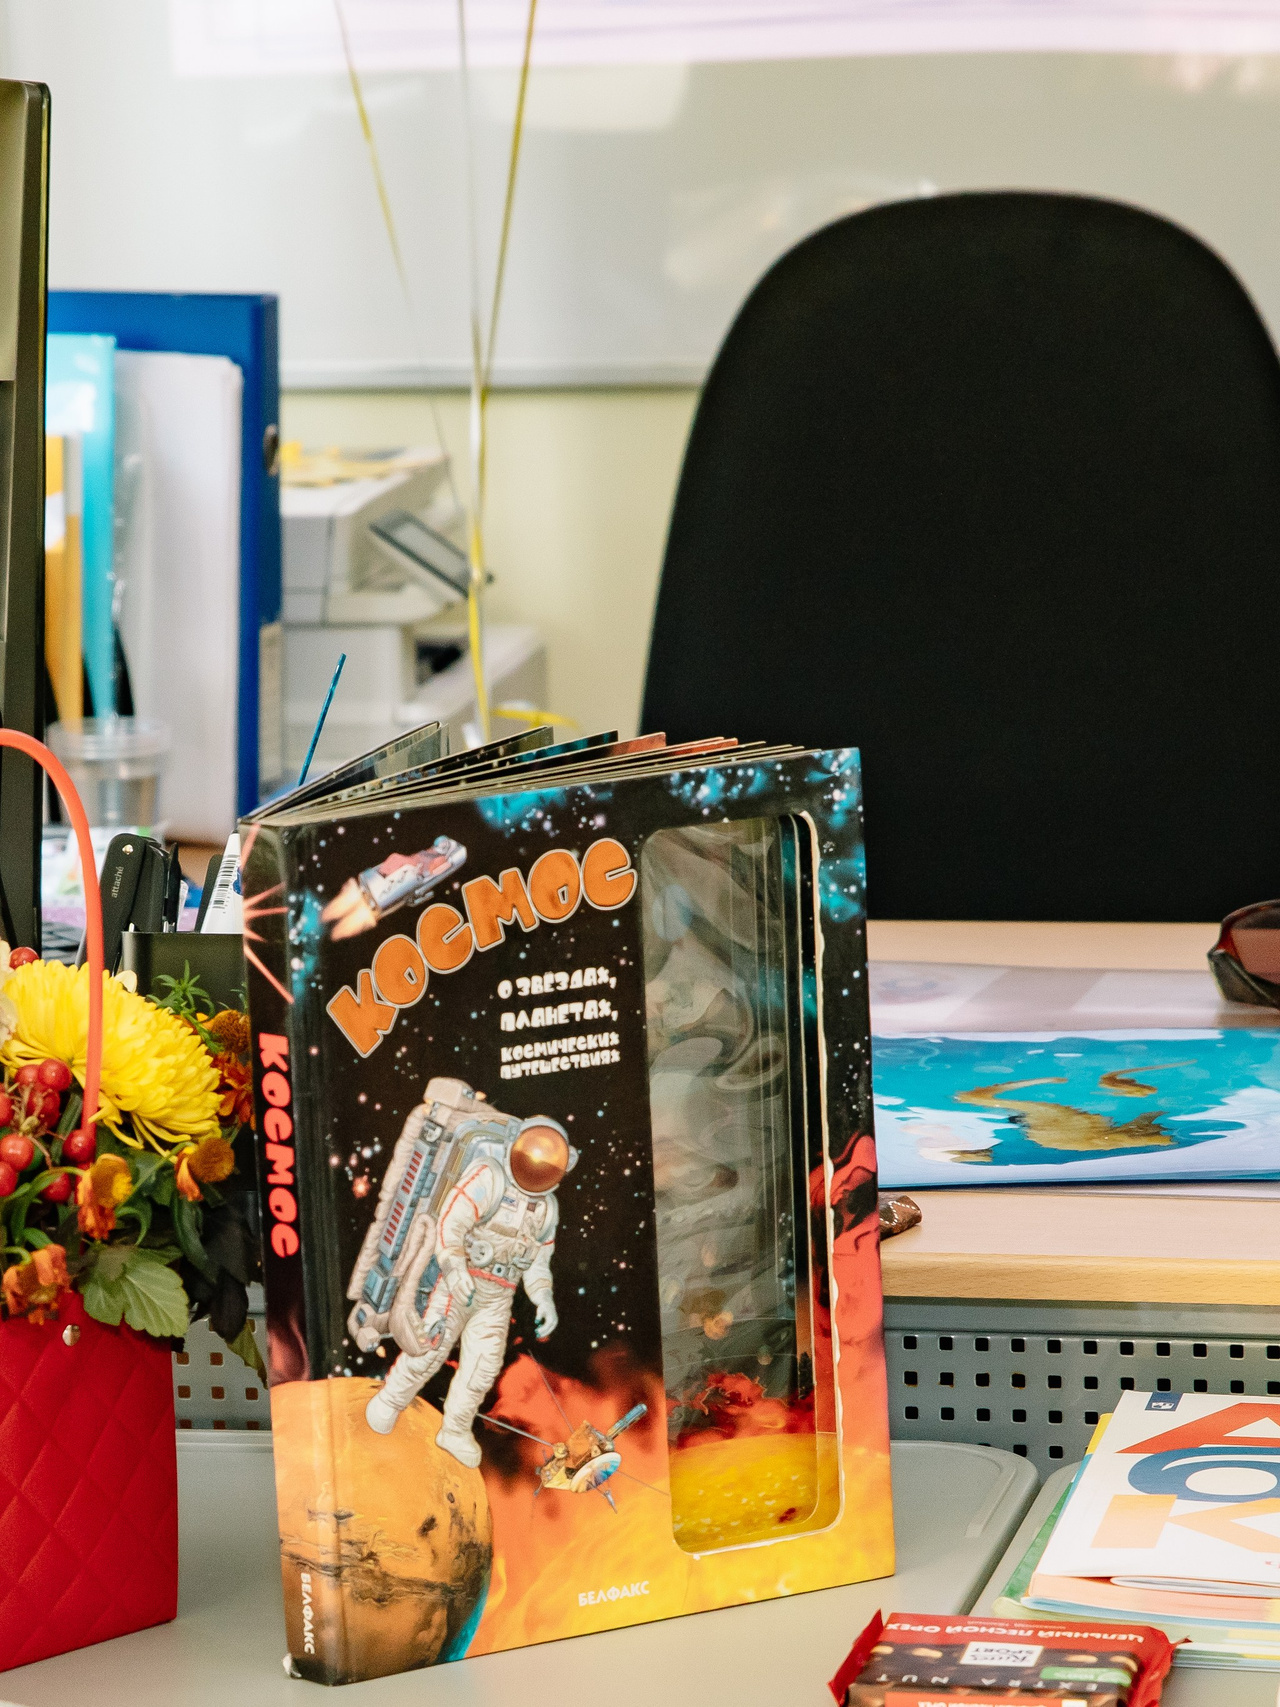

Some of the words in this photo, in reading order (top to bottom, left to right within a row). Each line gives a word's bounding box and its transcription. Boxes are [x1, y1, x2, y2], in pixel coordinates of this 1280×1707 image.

[326, 838, 638, 1058] КОСМОС
[497, 979, 513, 999] О
[500, 998, 619, 1032] ПЛАНЕТАХ,
[500, 1031, 620, 1063] КОСМИЧЕСКИХ
[500, 1049, 621, 1080] ПУТЕШЕСТВИЯХ
[258, 1032, 299, 1258] КОСМОС
[578, 1580, 650, 1607] БЕЛФАКС
[300, 1572, 315, 1655] БЕЛФАКС
[885, 1622, 941, 1634] ОРЕХ
[945, 1625, 1034, 1637] ЛЕСНОЙ
[1037, 1630, 1144, 1644] ЦЕЛЬНЫЙ
[876, 1673, 949, 1685] NUT
[981, 1677, 1098, 1692] EXTRA
